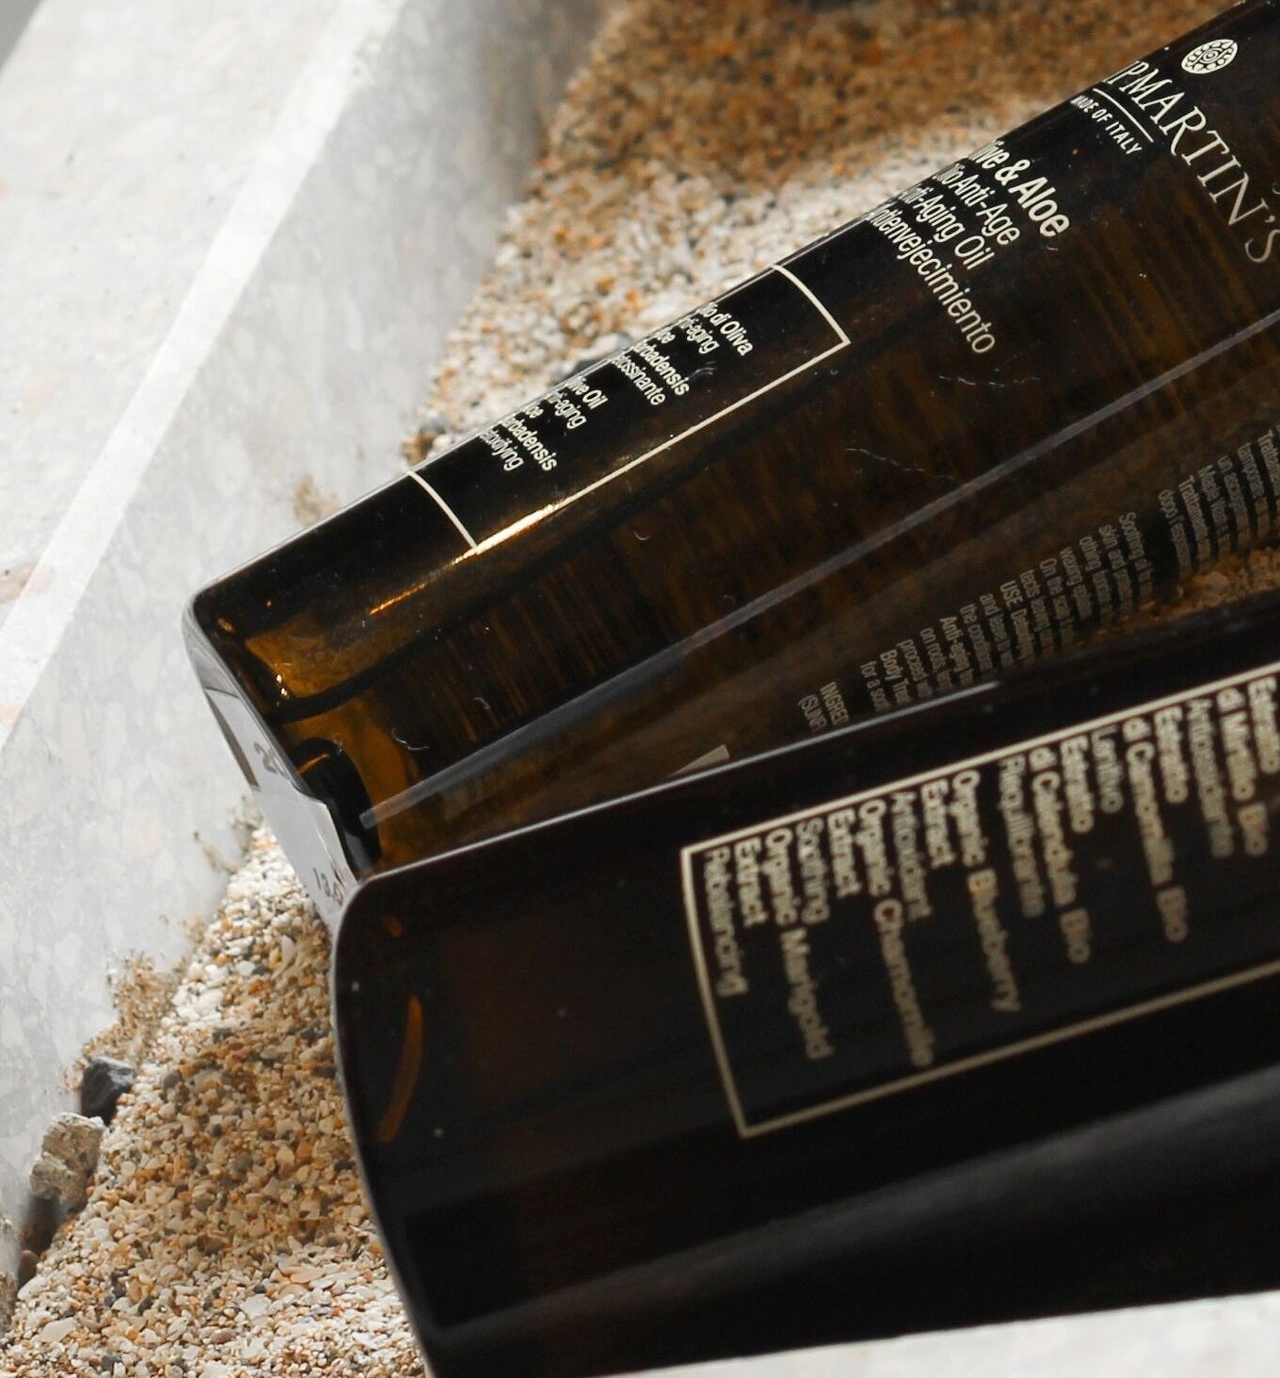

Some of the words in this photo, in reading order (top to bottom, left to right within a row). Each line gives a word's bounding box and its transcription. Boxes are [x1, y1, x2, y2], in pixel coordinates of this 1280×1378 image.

[1092, 109, 1113, 122] OF
[1105, 121, 1143, 154] ITALY
[994, 159, 1031, 186] &
[948, 174, 1021, 246] Anti-Age
[1008, 176, 1070, 237] Aloe
[954, 235, 995, 270] Oil
[719, 320, 754, 356] Oliva
[582, 389, 608, 410] Oil
[1196, 462, 1221, 504] Maple
[1216, 452, 1233, 474] un
[1156, 486, 1178, 522] dopo
[1078, 531, 1102, 573] othing
[1098, 520, 1119, 551] skin
[1118, 508, 1146, 562] Soothing
[1039, 554, 1058, 579] On
[1058, 543, 1083, 588] waxing
[1107, 545, 1125, 571] and
[979, 589, 999, 619] and
[1019, 567, 1041, 601] tects
[1046, 574, 1064, 597] the
[959, 601, 978, 627] the
[919, 624, 935, 646] on
[939, 610, 971, 675] Anti-aging
[859, 658, 879, 682] for
[878, 645, 905, 685] Body
[896, 633, 926, 687] proceed
[853, 798, 890, 894] Organic
[1236, 801, 1267, 855] Bio
[761, 827, 800, 924] Organic
[948, 769, 984, 865] Organic
[966, 867, 1019, 1011] Blueberry
[1155, 885, 1188, 942] Bio
[1059, 907, 1090, 963] Bio
[779, 927, 832, 1058] Marigold
